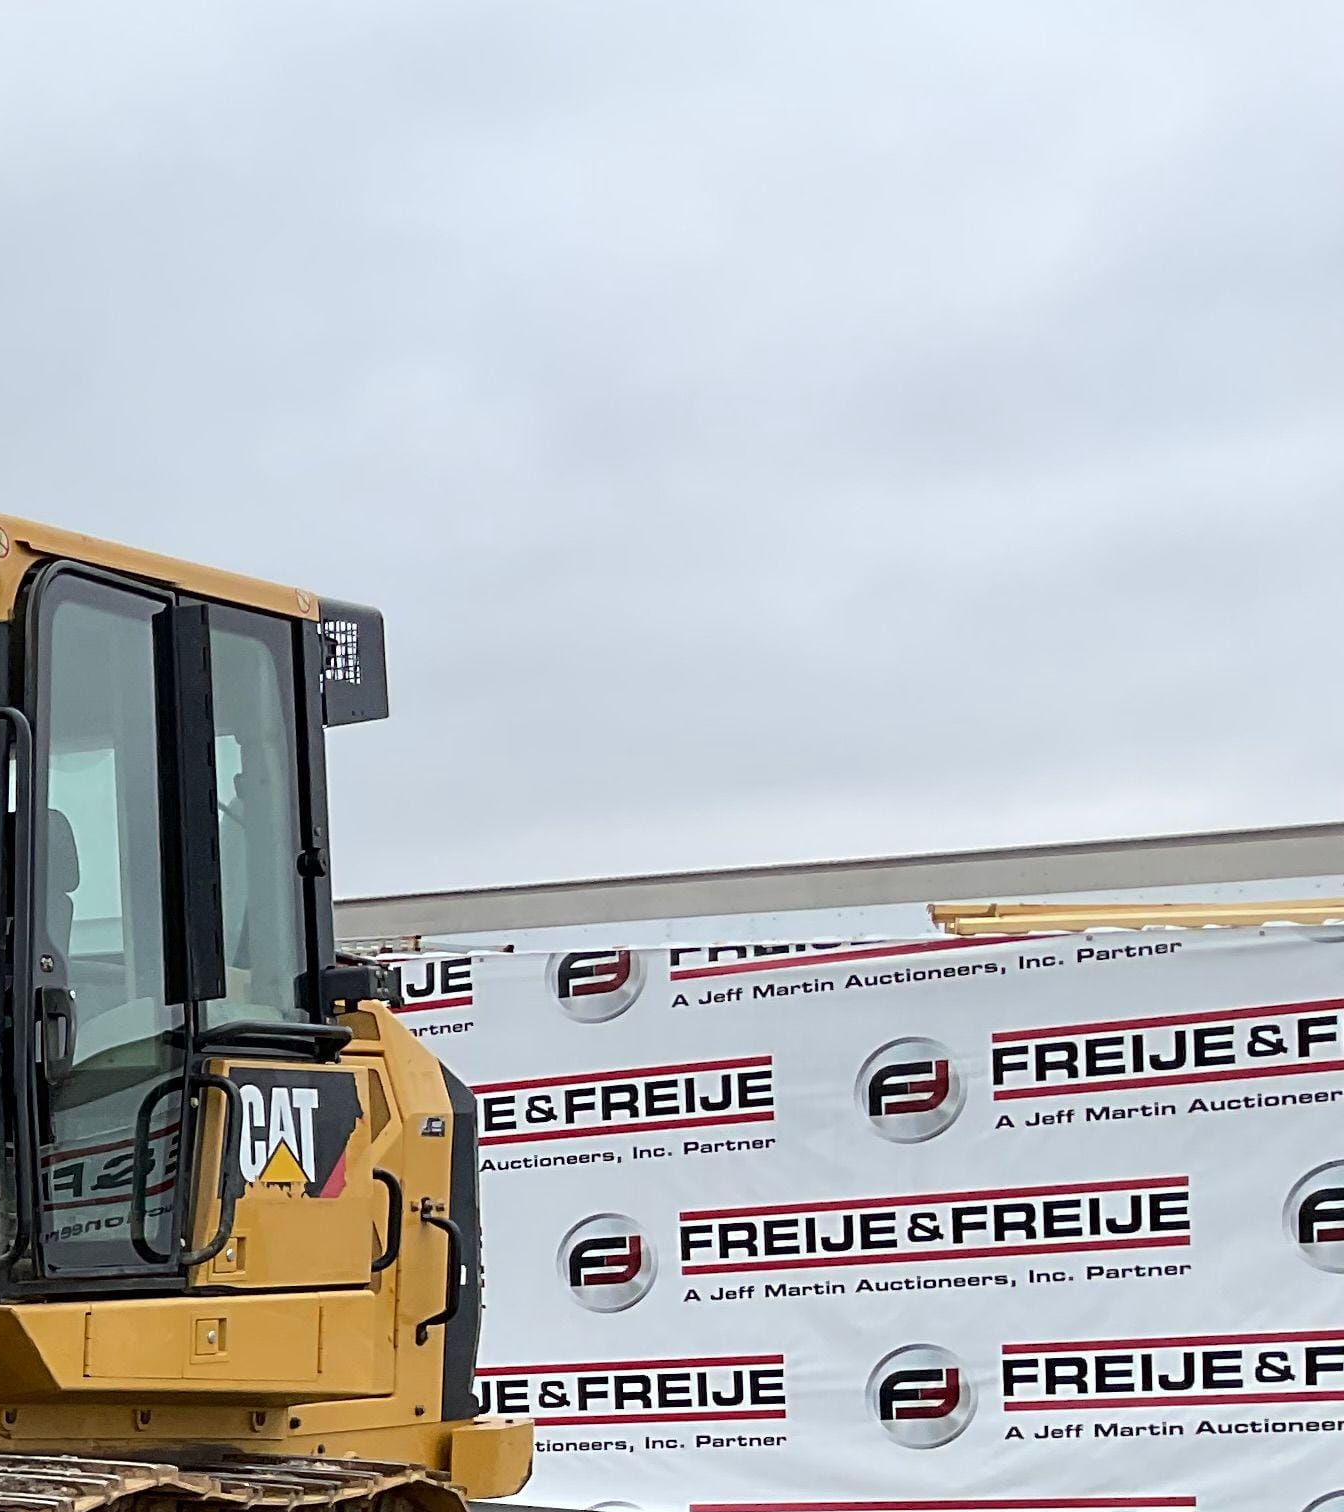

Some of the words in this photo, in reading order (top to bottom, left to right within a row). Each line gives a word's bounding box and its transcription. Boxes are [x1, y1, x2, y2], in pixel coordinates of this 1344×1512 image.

[671, 994, 689, 1008] A
[698, 987, 743, 1005] Jeff
[753, 979, 834, 999] Martin
[844, 963, 1006, 989] Auctioneers,
[1019, 955, 1065, 970] Inc.
[1077, 942, 1182, 963] Partner
[995, 1115, 1015, 1129] A
[1025, 1109, 1075, 1127] Jeff
[1085, 1103, 1176, 1122] Martin
[1187, 1091, 1343, 1114] Auctioneer
[240, 1084, 318, 1183] CAT
[479, 1152, 622, 1173] Auctioneers,
[632, 1147, 673, 1160] Inc.
[683, 1138, 777, 1155] Partner
[683, 1289, 701, 1302] A
[710, 1286, 755, 1301] Jeff
[764, 1281, 845, 1298] Martin
[855, 1275, 1016, 1293] Auctioneers,
[1029, 1269, 1074, 1284] Inc.
[1086, 1263, 1192, 1280] Partner
[645, 1436, 686, 1450] Inc.
[696, 1435, 788, 1448] Partner
[1004, 1426, 1025, 1440] A
[1034, 1425, 1083, 1439] Jeff
[1094, 1421, 1184, 1438] Martin
